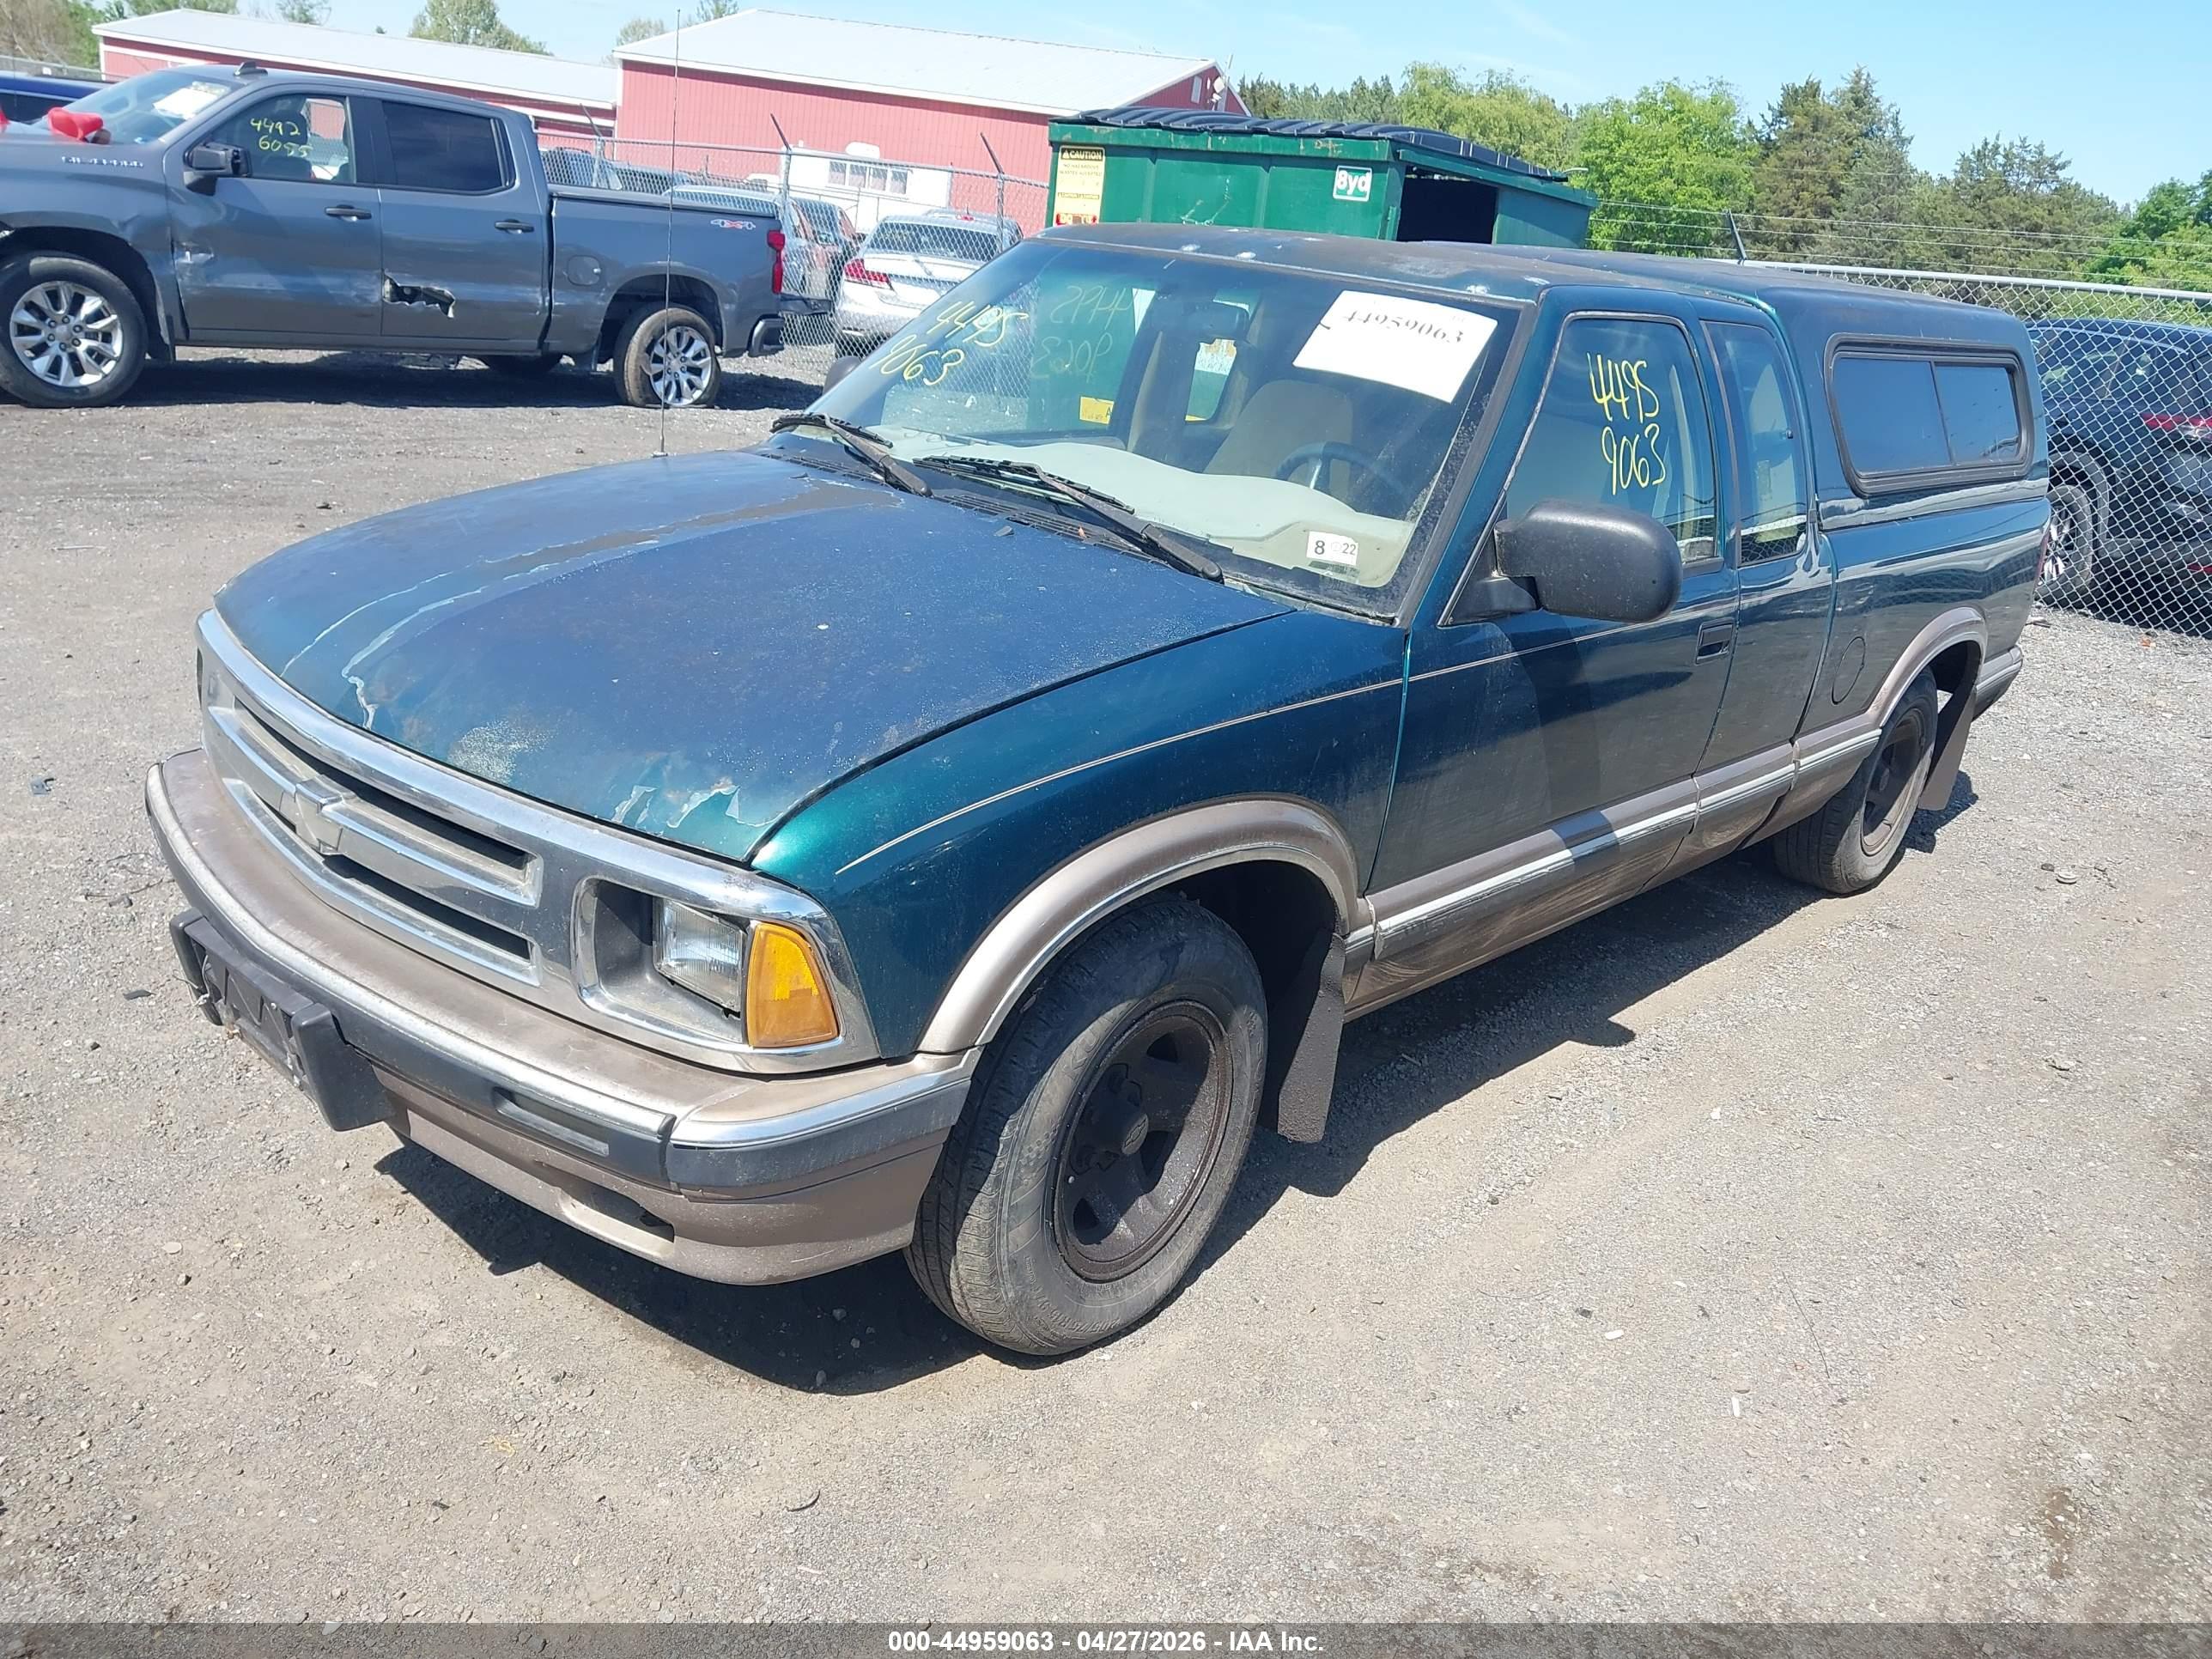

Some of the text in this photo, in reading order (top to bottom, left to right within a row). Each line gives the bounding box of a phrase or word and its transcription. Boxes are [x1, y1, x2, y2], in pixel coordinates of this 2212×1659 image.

[250, 118, 301, 136] 4492
[1069, 149, 1103, 161] CAUTION
[1337, 170, 1371, 195] 8yd
[1586, 352, 1660, 424] 4495
[1601, 422, 1667, 496] 9063
[1314, 539, 1357, 556] 8 22
